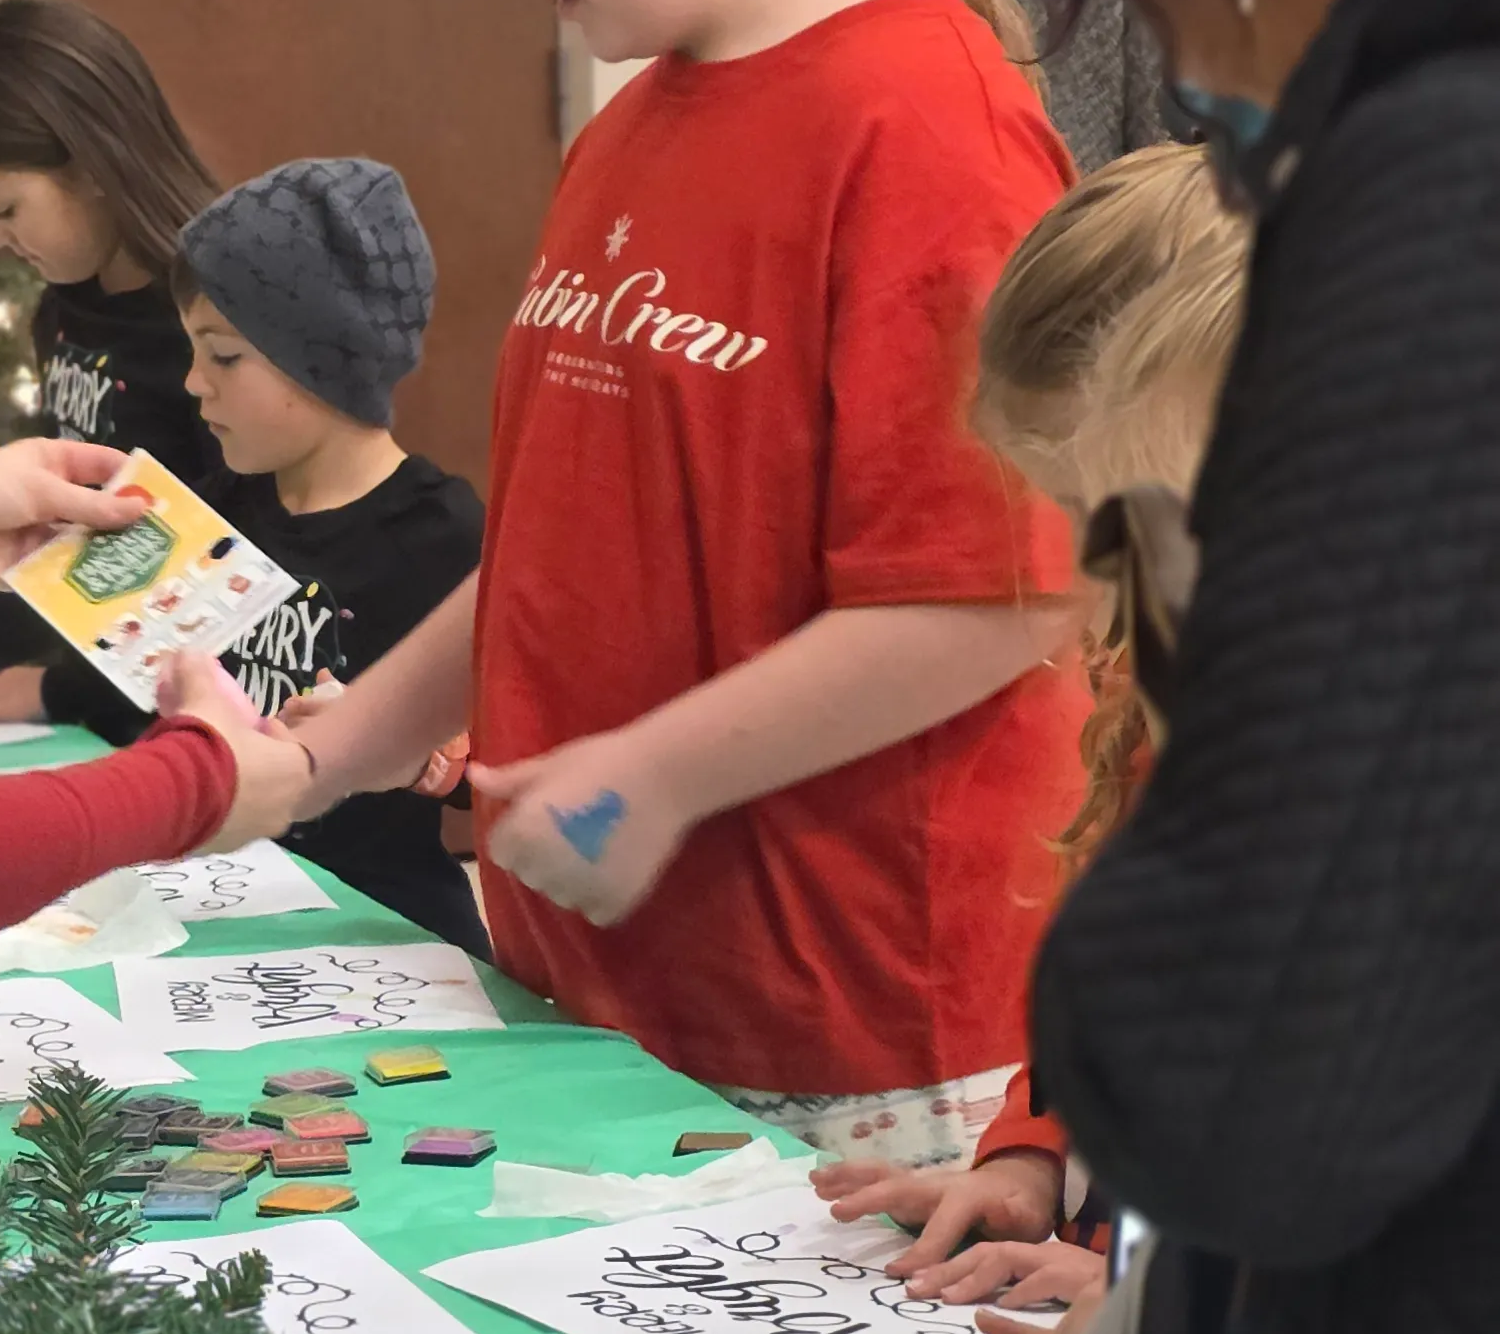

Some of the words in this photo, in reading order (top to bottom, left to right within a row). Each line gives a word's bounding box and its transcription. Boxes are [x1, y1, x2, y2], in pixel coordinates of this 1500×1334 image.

[601, 267, 769, 372] Crew
[232, 600, 333, 672] ERRY
[167, 980, 216, 1023] MERRY
[211, 961, 354, 1030] Bright
[662, 1302, 713, 1317] &
